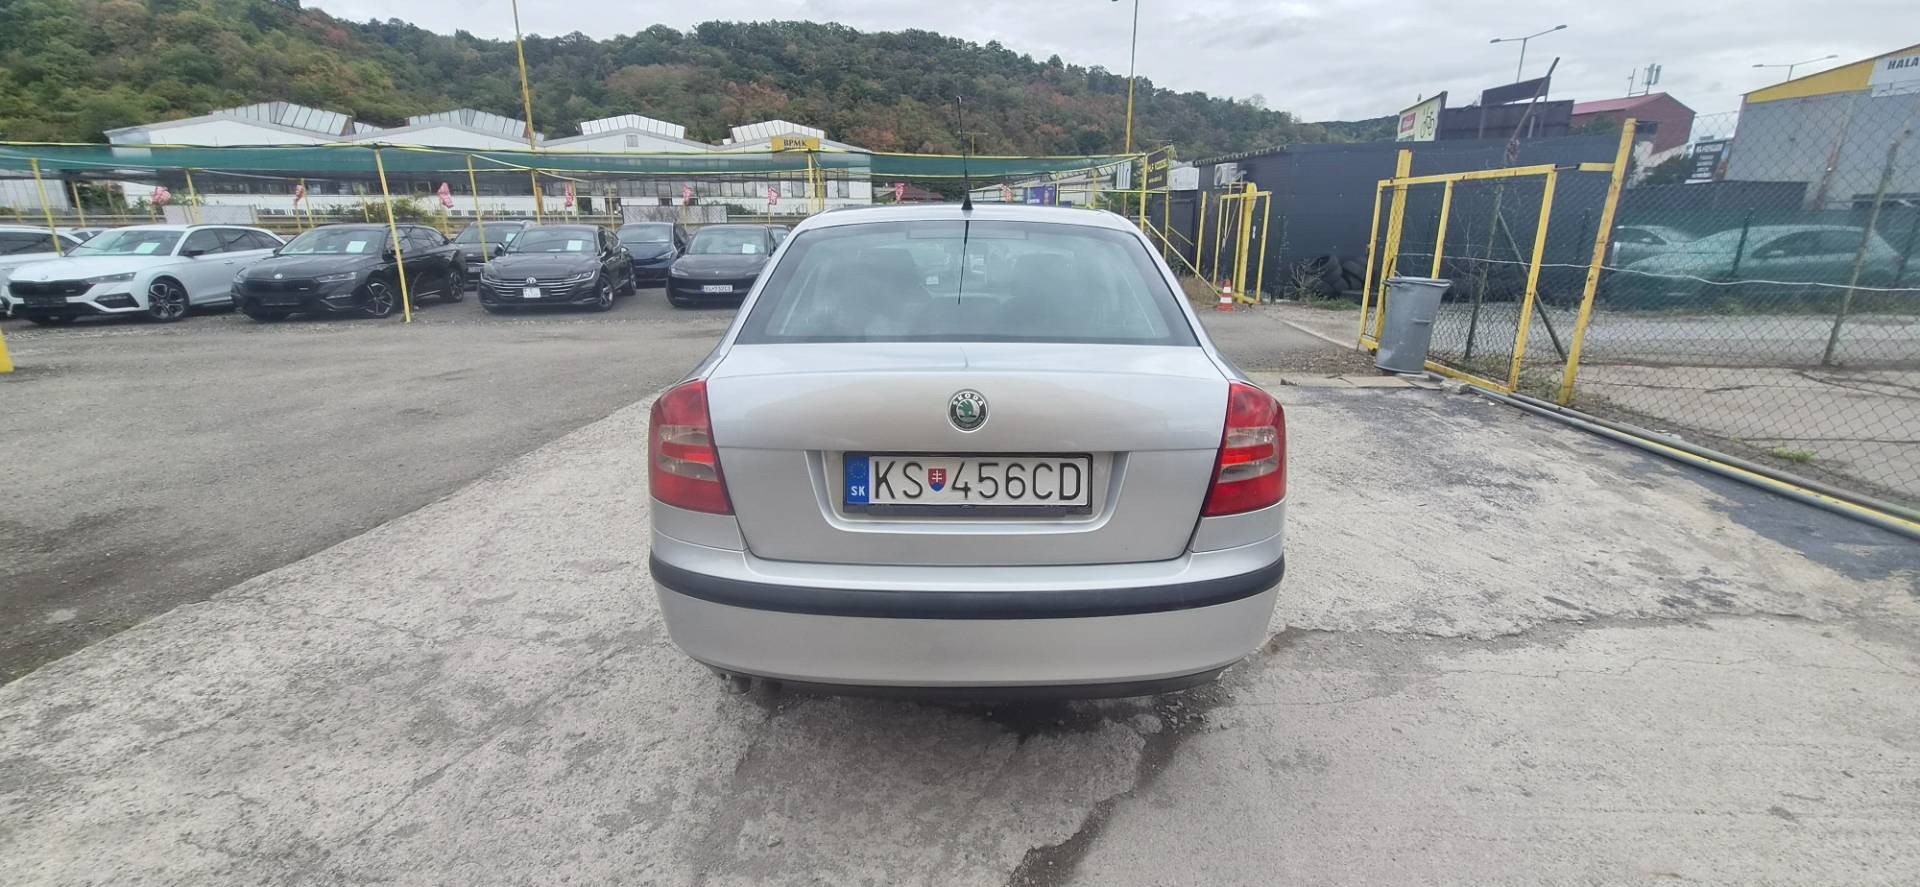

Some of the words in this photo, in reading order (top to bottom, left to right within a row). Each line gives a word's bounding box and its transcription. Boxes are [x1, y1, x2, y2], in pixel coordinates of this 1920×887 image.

[1887, 57, 1919, 70] HALA
[874, 460, 923, 500] KS
[951, 462, 1082, 501] 456CD
[851, 485, 865, 497] SK
